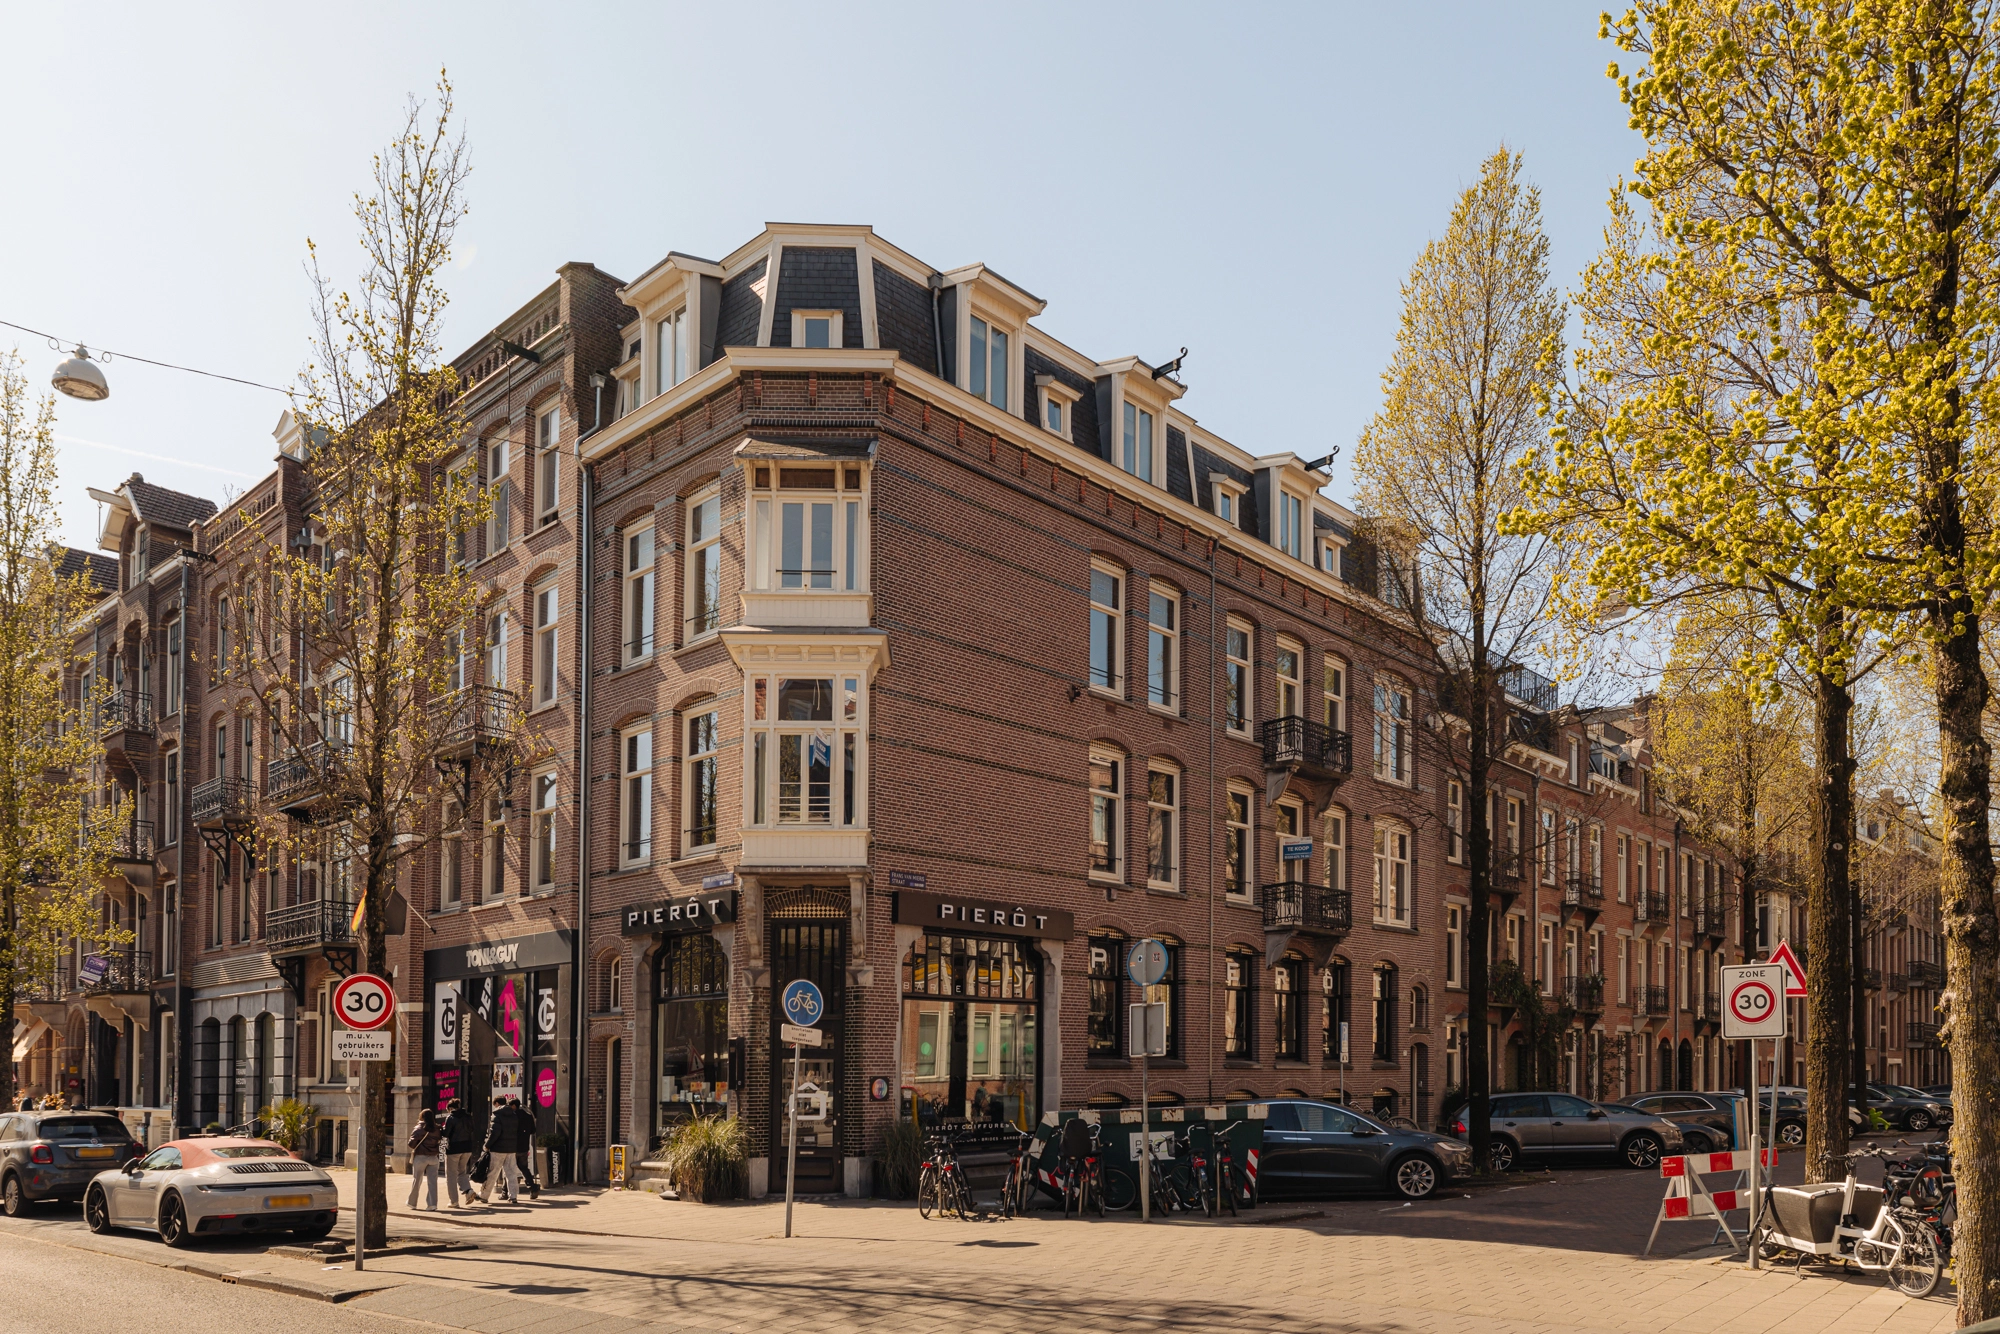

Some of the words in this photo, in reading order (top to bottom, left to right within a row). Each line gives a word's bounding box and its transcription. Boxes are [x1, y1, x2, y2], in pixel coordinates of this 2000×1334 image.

[628, 896, 720, 927] PIERÔT
[941, 904, 1047, 929] PIERÔT
[466, 943, 519, 968] TONI&GUY
[1739, 970, 1765, 978] ZONE
[346, 991, 383, 1013] 30
[1739, 994, 1767, 1010] 30
[338, 1042, 384, 1050] gebruikers
[461, 1013, 471, 1063] TONI&GUY
[440, 1087, 455, 1099] BOOK
[925, 1123, 958, 1131] PIERÔT
